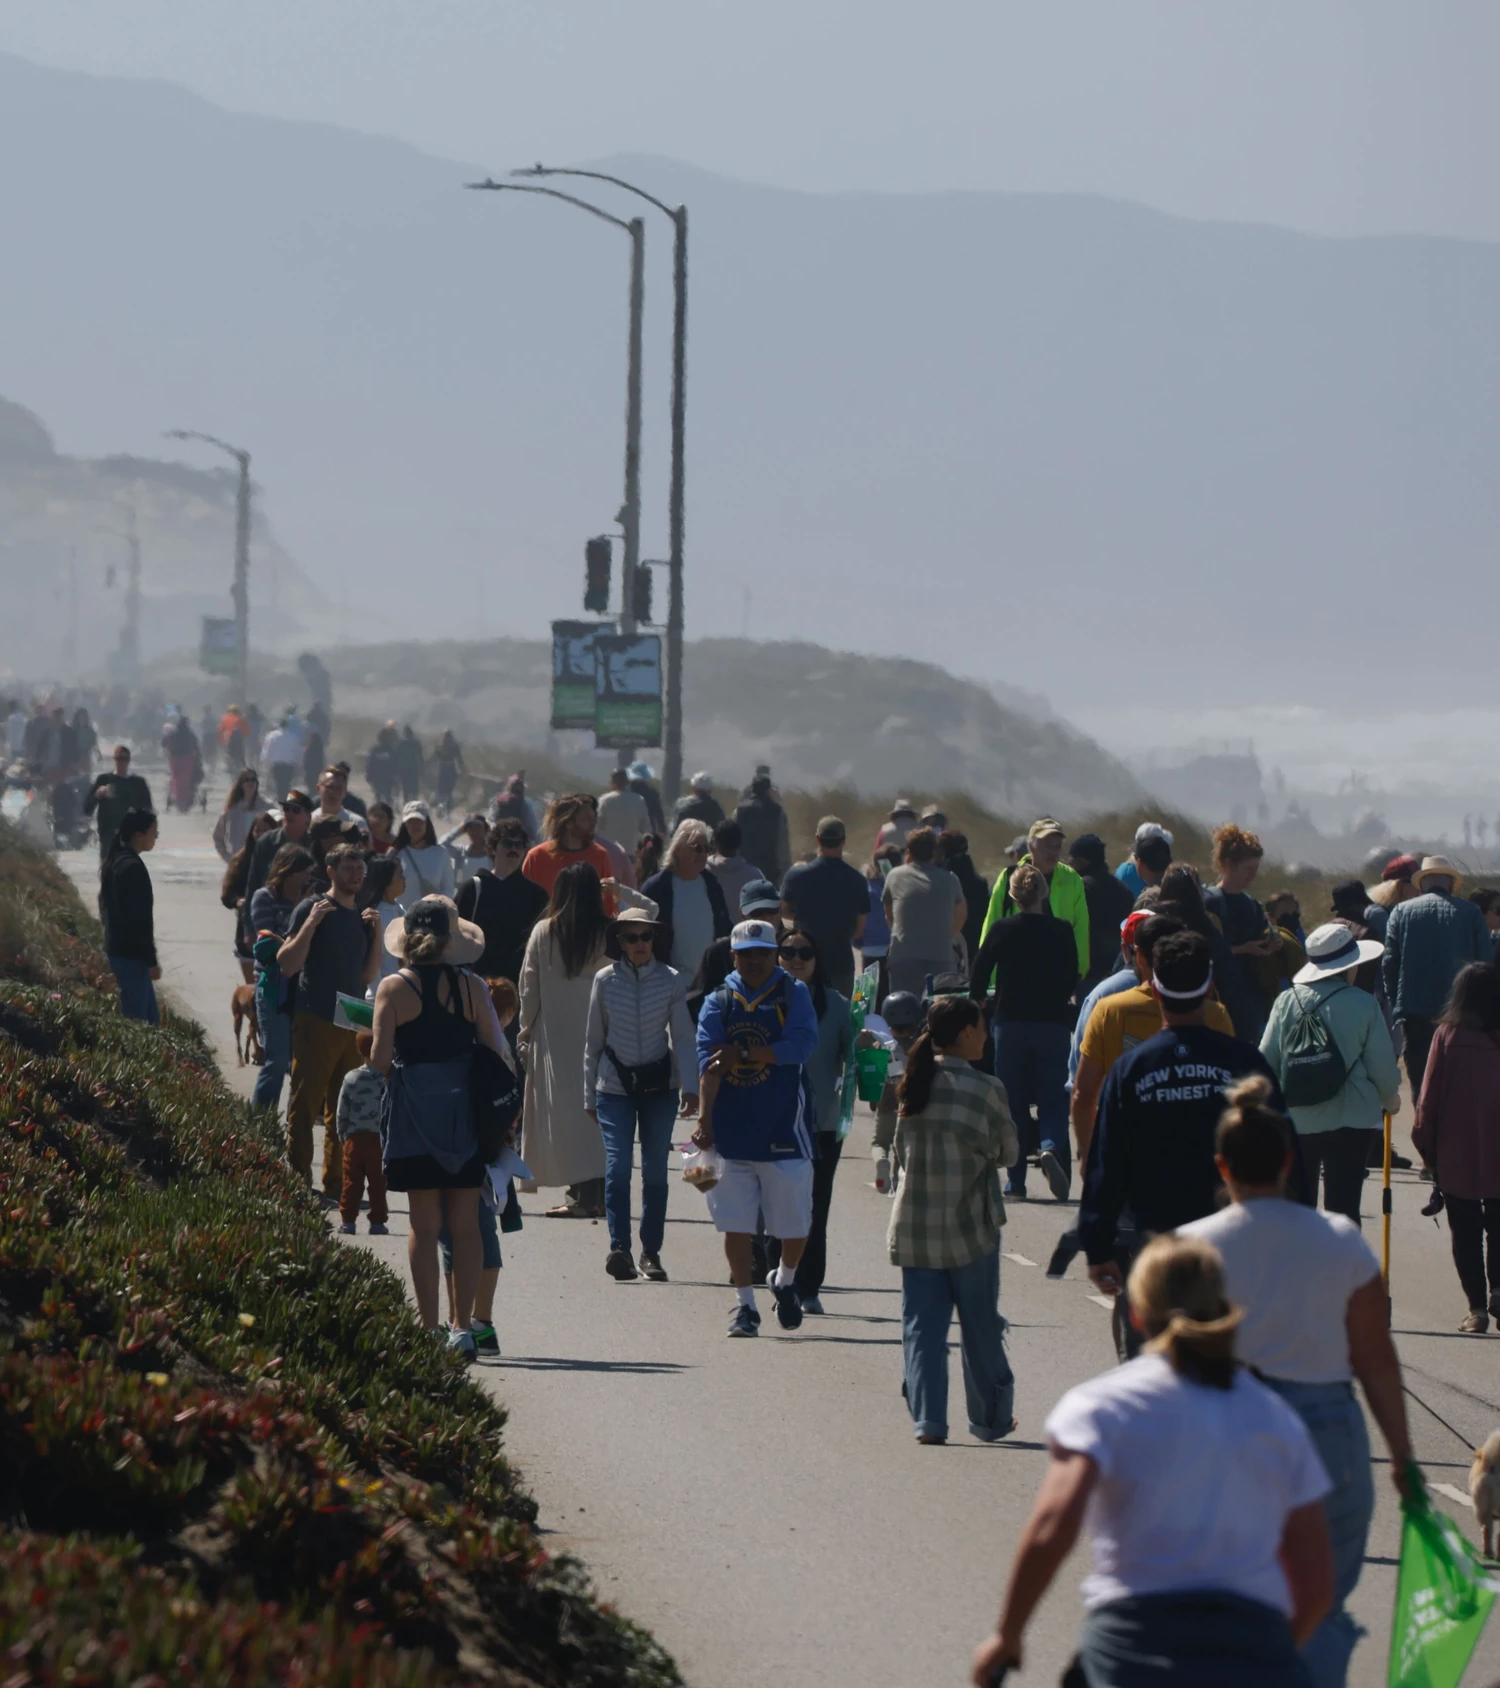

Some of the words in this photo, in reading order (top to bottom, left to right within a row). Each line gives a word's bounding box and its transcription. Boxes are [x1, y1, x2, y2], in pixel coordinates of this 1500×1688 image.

[1135, 1067, 1170, 1096] NEW
[1173, 1064, 1232, 1084] YORK'S
[1140, 1093, 1152, 1103] NY
[1156, 1084, 1211, 1102] FINEST
